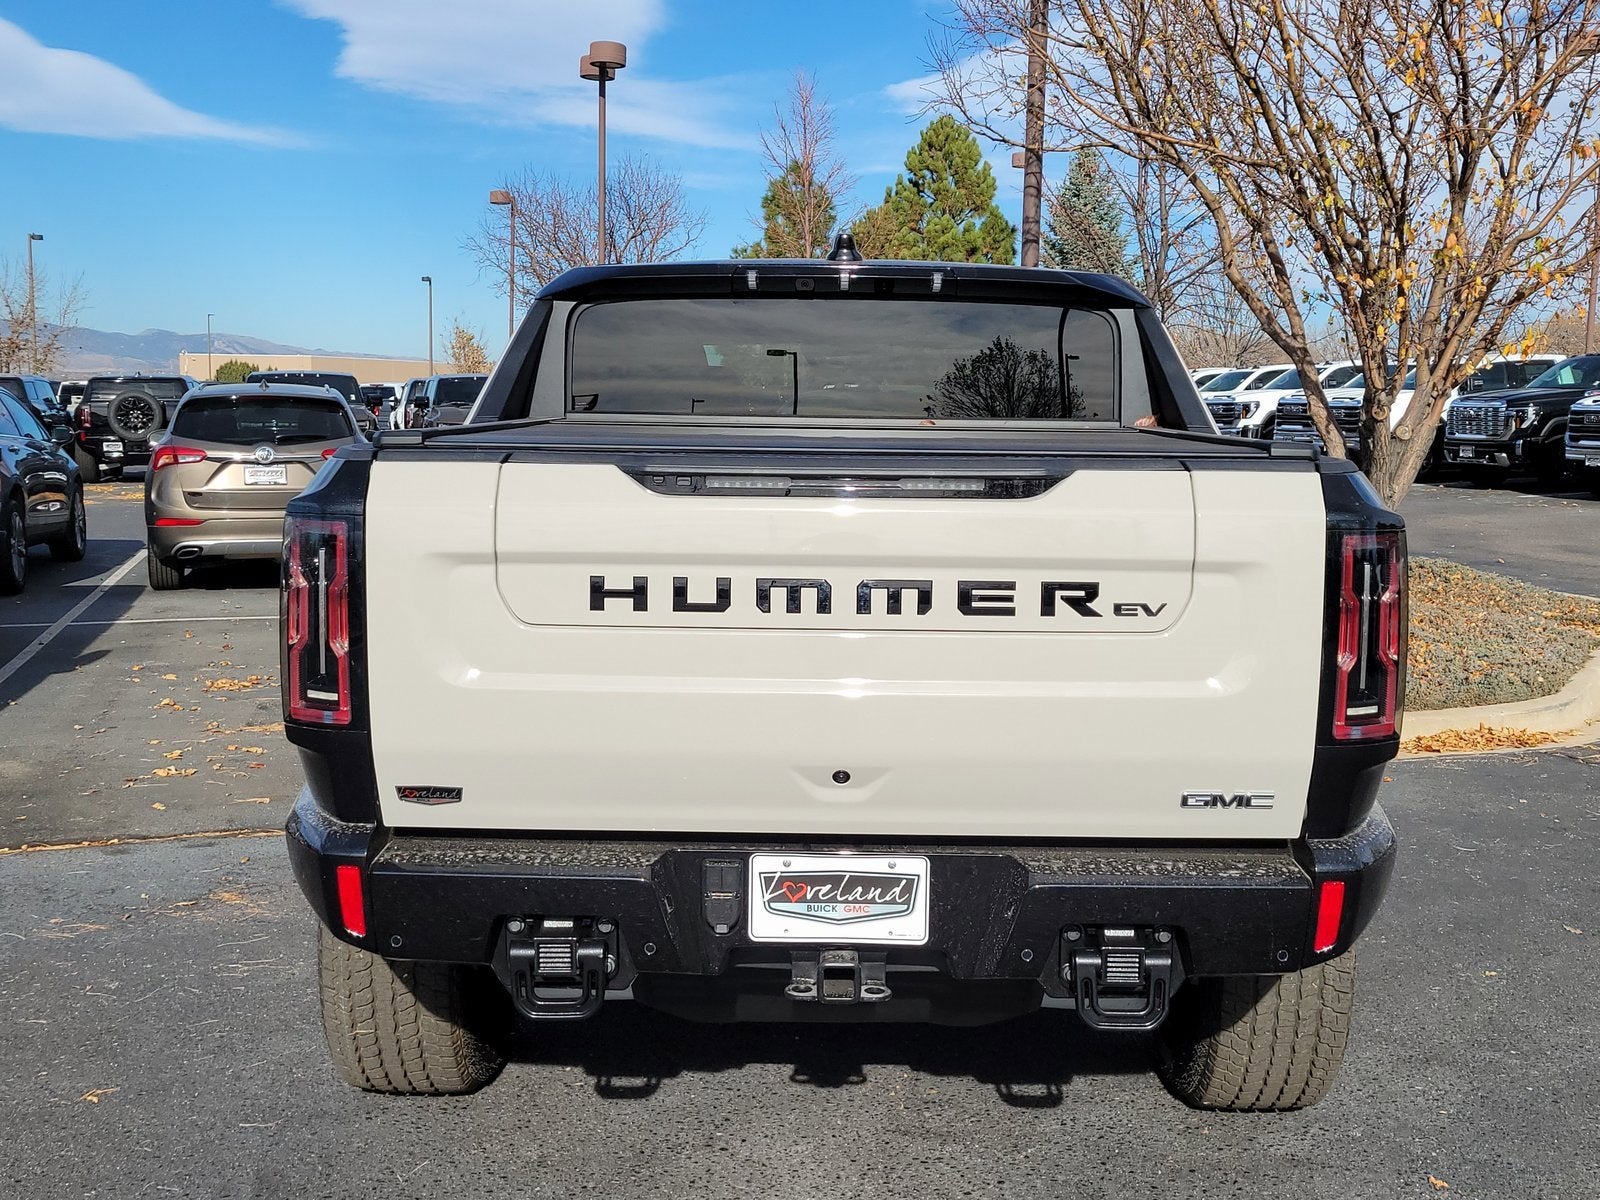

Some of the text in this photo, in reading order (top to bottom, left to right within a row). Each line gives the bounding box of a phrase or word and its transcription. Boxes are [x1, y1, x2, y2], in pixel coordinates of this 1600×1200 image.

[589, 575, 1167, 618] HUMMER EV
[1180, 791, 1275, 809] GMC
[764, 871, 910, 904] Loveland
[806, 904, 871, 914] BUICK GMC
